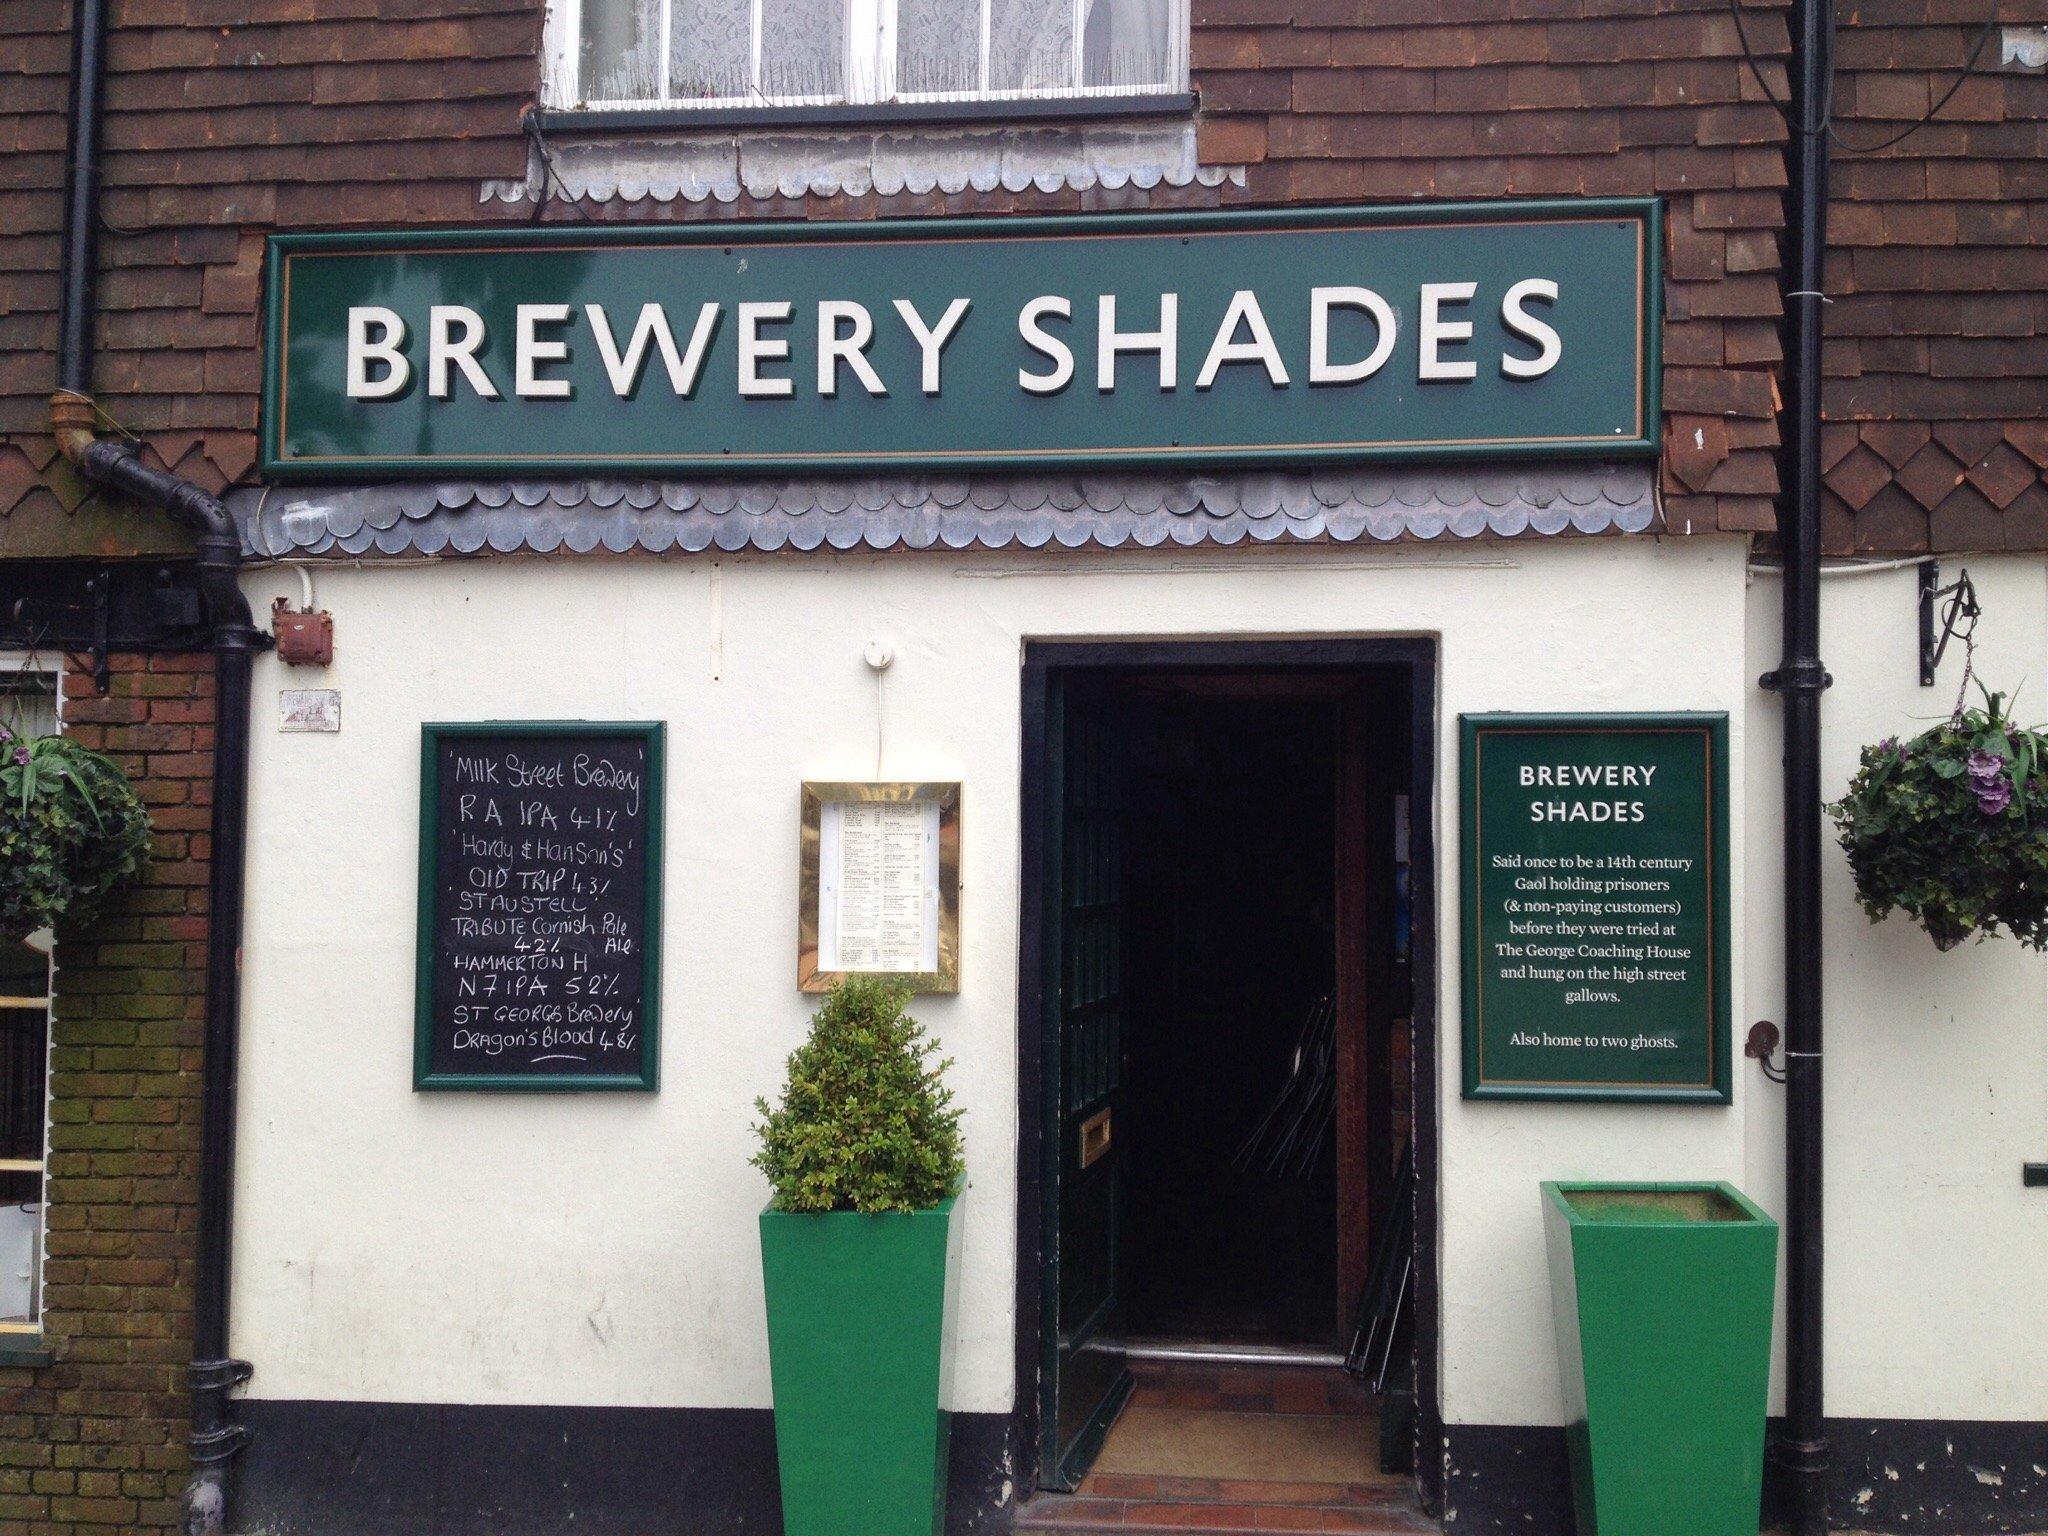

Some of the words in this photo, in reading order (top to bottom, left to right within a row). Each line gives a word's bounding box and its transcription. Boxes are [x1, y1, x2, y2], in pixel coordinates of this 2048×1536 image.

[346, 297, 972, 398] BREWERY
[1016, 277, 1563, 395] SHADES
[505, 753, 565, 788] Street
[1519, 765, 1657, 786] BREWERY
[520, 800, 559, 831] IPA
[1530, 801, 1645, 822] SHADES
[521, 839, 533, 860] &
[1492, 854, 1522, 868] Said
[1524, 857, 1557, 868] once
[1560, 855, 1574, 868] to
[1576, 855, 1594, 869] be
[1596, 859, 1605, 869] a
[1607, 855, 1636, 869] 14th
[1639, 856, 1693, 872] century
[516, 868, 566, 892] TRIP
[1514, 877, 1547, 890] Gaol
[1550, 877, 1602, 893] holding
[1604, 878, 1670, 894] prisoners
[1503, 898, 1522, 914] (&
[1524, 900, 1602, 915] non-paying
[1604, 899, 1682, 915] customers)
[532, 914, 595, 935] Cornish
[601, 911, 627, 936] Pale
[1509, 921, 1554, 935] before
[1556, 922, 1587, 938] they
[1589, 925, 1624, 936] were
[1626, 922, 1660, 936] tried
[1662, 924, 1677, 936] at
[1495, 943, 1523, 957] The
[1526, 944, 1575, 960] George
[1578, 944, 1644, 960] Coaching
[1646, 945, 1692, 959] House
[573, 952, 589, 973] H
[1500, 965, 1526, 979] and
[1529, 966, 1565, 982] hung
[1567, 969, 1585, 980] on
[1588, 966, 1610, 980] the
[1613, 966, 1644, 983] high
[1647, 968, 1687, 981] street
[1565, 987, 1621, 1005] gallows.
[453, 1005, 490, 1025] ST
[541, 1025, 594, 1048] Blood
[1510, 1033, 1541, 1046] Also
[1543, 1033, 1582, 1046] home
[1585, 1035, 1599, 1047] to
[1601, 1035, 1628, 1048] two
[1630, 1034, 1678, 1051] ghosts.
